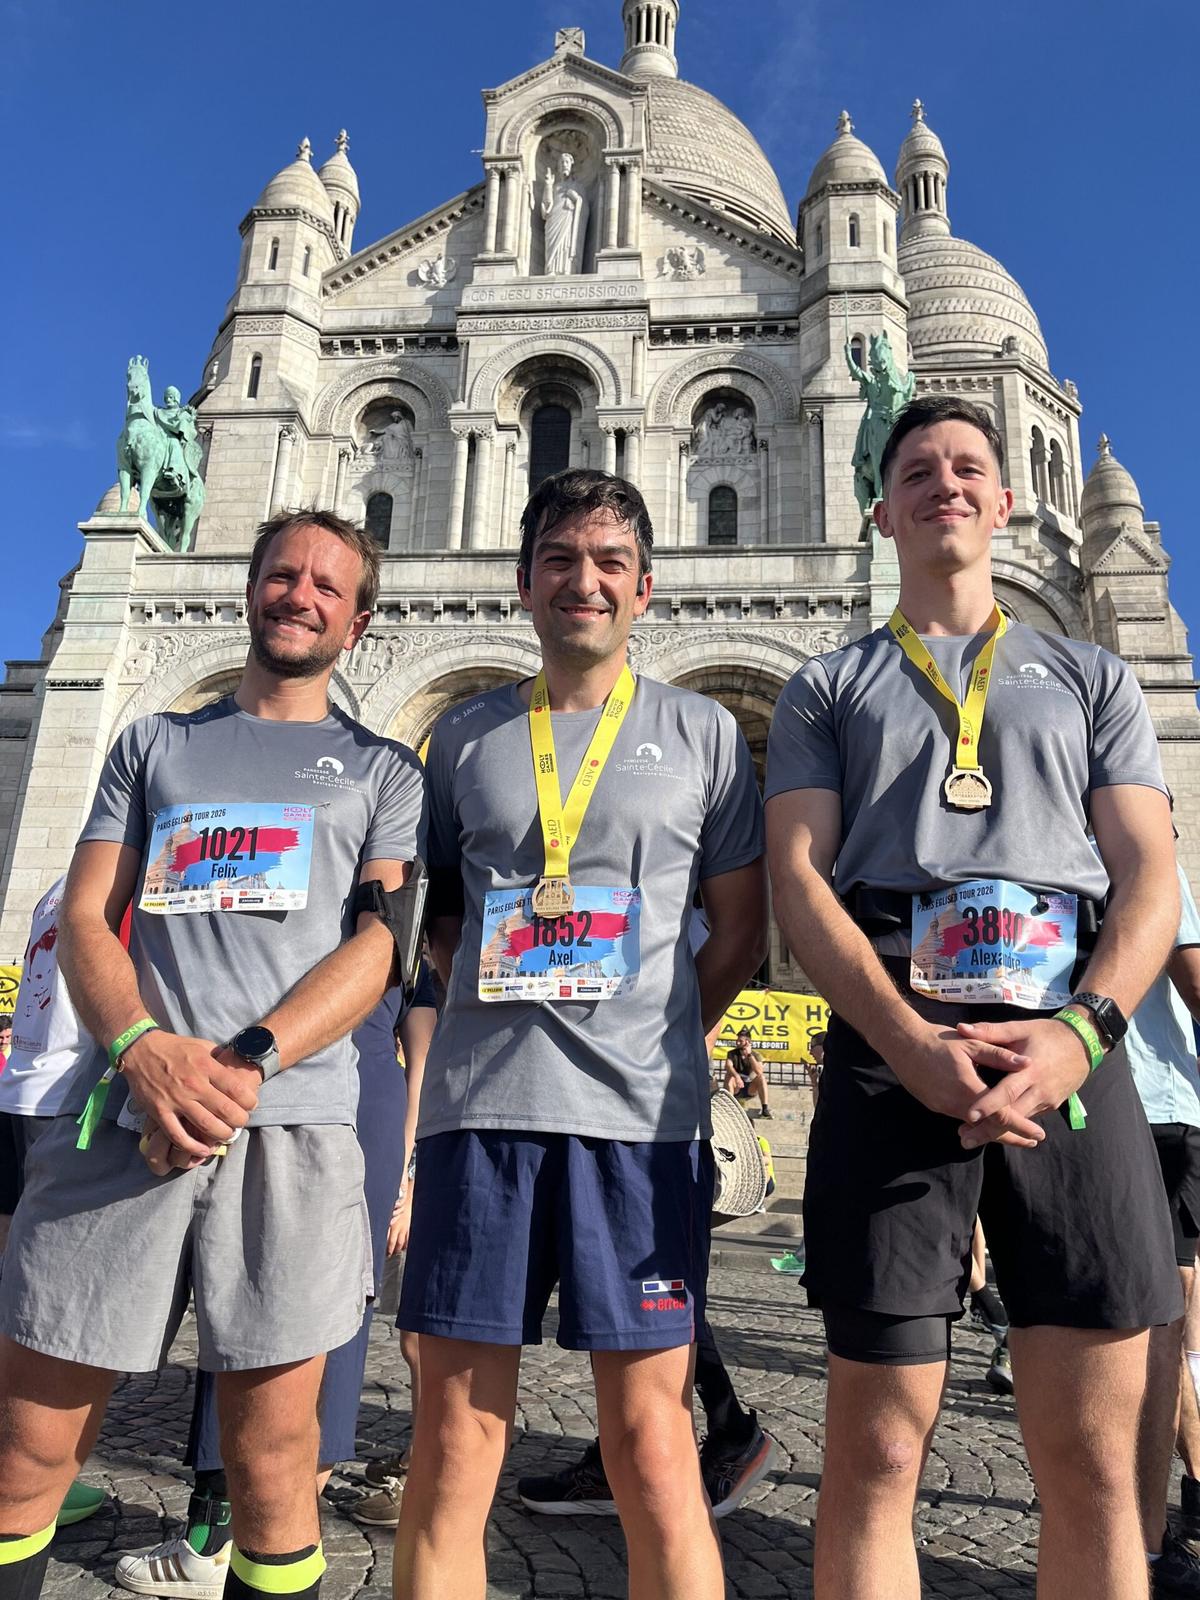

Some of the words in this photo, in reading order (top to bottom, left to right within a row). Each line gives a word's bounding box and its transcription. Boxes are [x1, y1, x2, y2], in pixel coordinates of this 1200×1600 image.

[471, 290, 495, 302] COR
[500, 288, 532, 301] JESU
[463, 702, 485, 717] JAKO
[538, 754, 546, 774] HOLY
[294, 770, 356, 787] Sainte-Cécile
[582, 769, 594, 787] AED
[156, 821, 171, 832] PARIS
[195, 811, 210, 821] TOUR
[210, 808, 227, 819] 2026
[547, 819, 558, 837] AED
[199, 826, 259, 861] 1021
[211, 863, 239, 879] Felix
[959, 889, 976, 901] TOUR
[976, 885, 994, 897] 2026
[487, 905, 504, 916] PARIS
[532, 910, 592, 948] 1852
[548, 949, 573, 966] Axel
[724, 1002, 791, 1021] OLY
[721, 1024, 790, 1037] AMES
